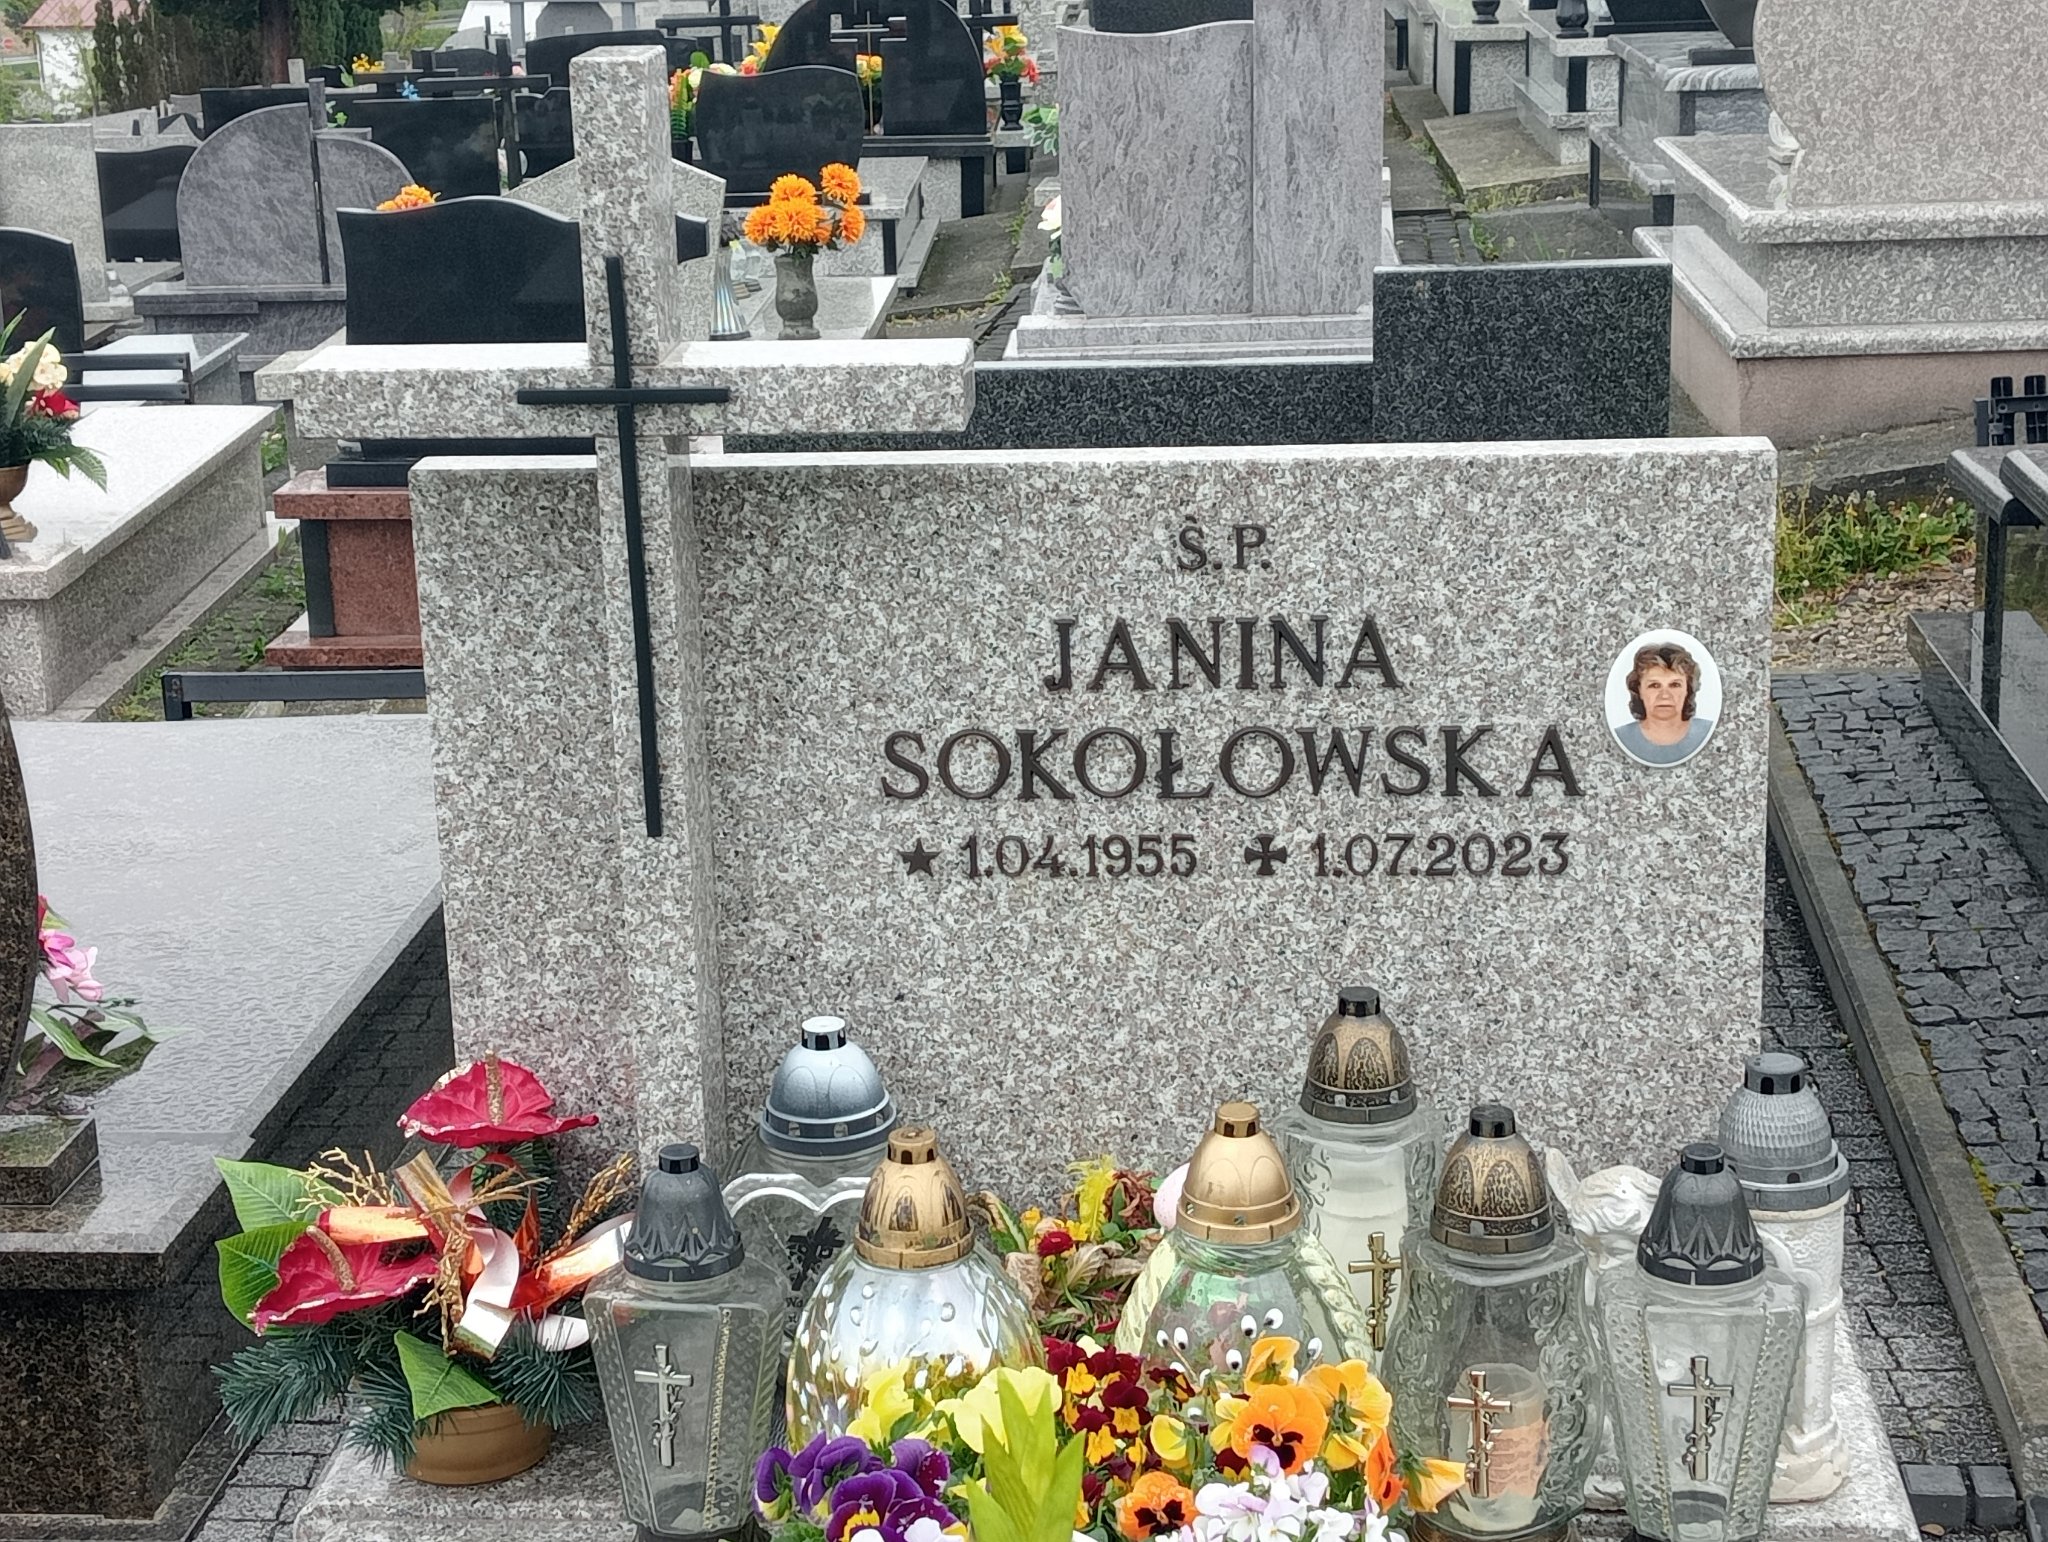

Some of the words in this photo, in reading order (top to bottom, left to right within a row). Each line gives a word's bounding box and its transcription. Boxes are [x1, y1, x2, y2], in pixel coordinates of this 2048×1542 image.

[1044, 614, 1401, 691] JANINA
[881, 725, 1585, 800] SOKOŁOWSKA
[960, 833, 1198, 878] 1.04.1955
[1310, 832, 1570, 877] 1.07.2023
